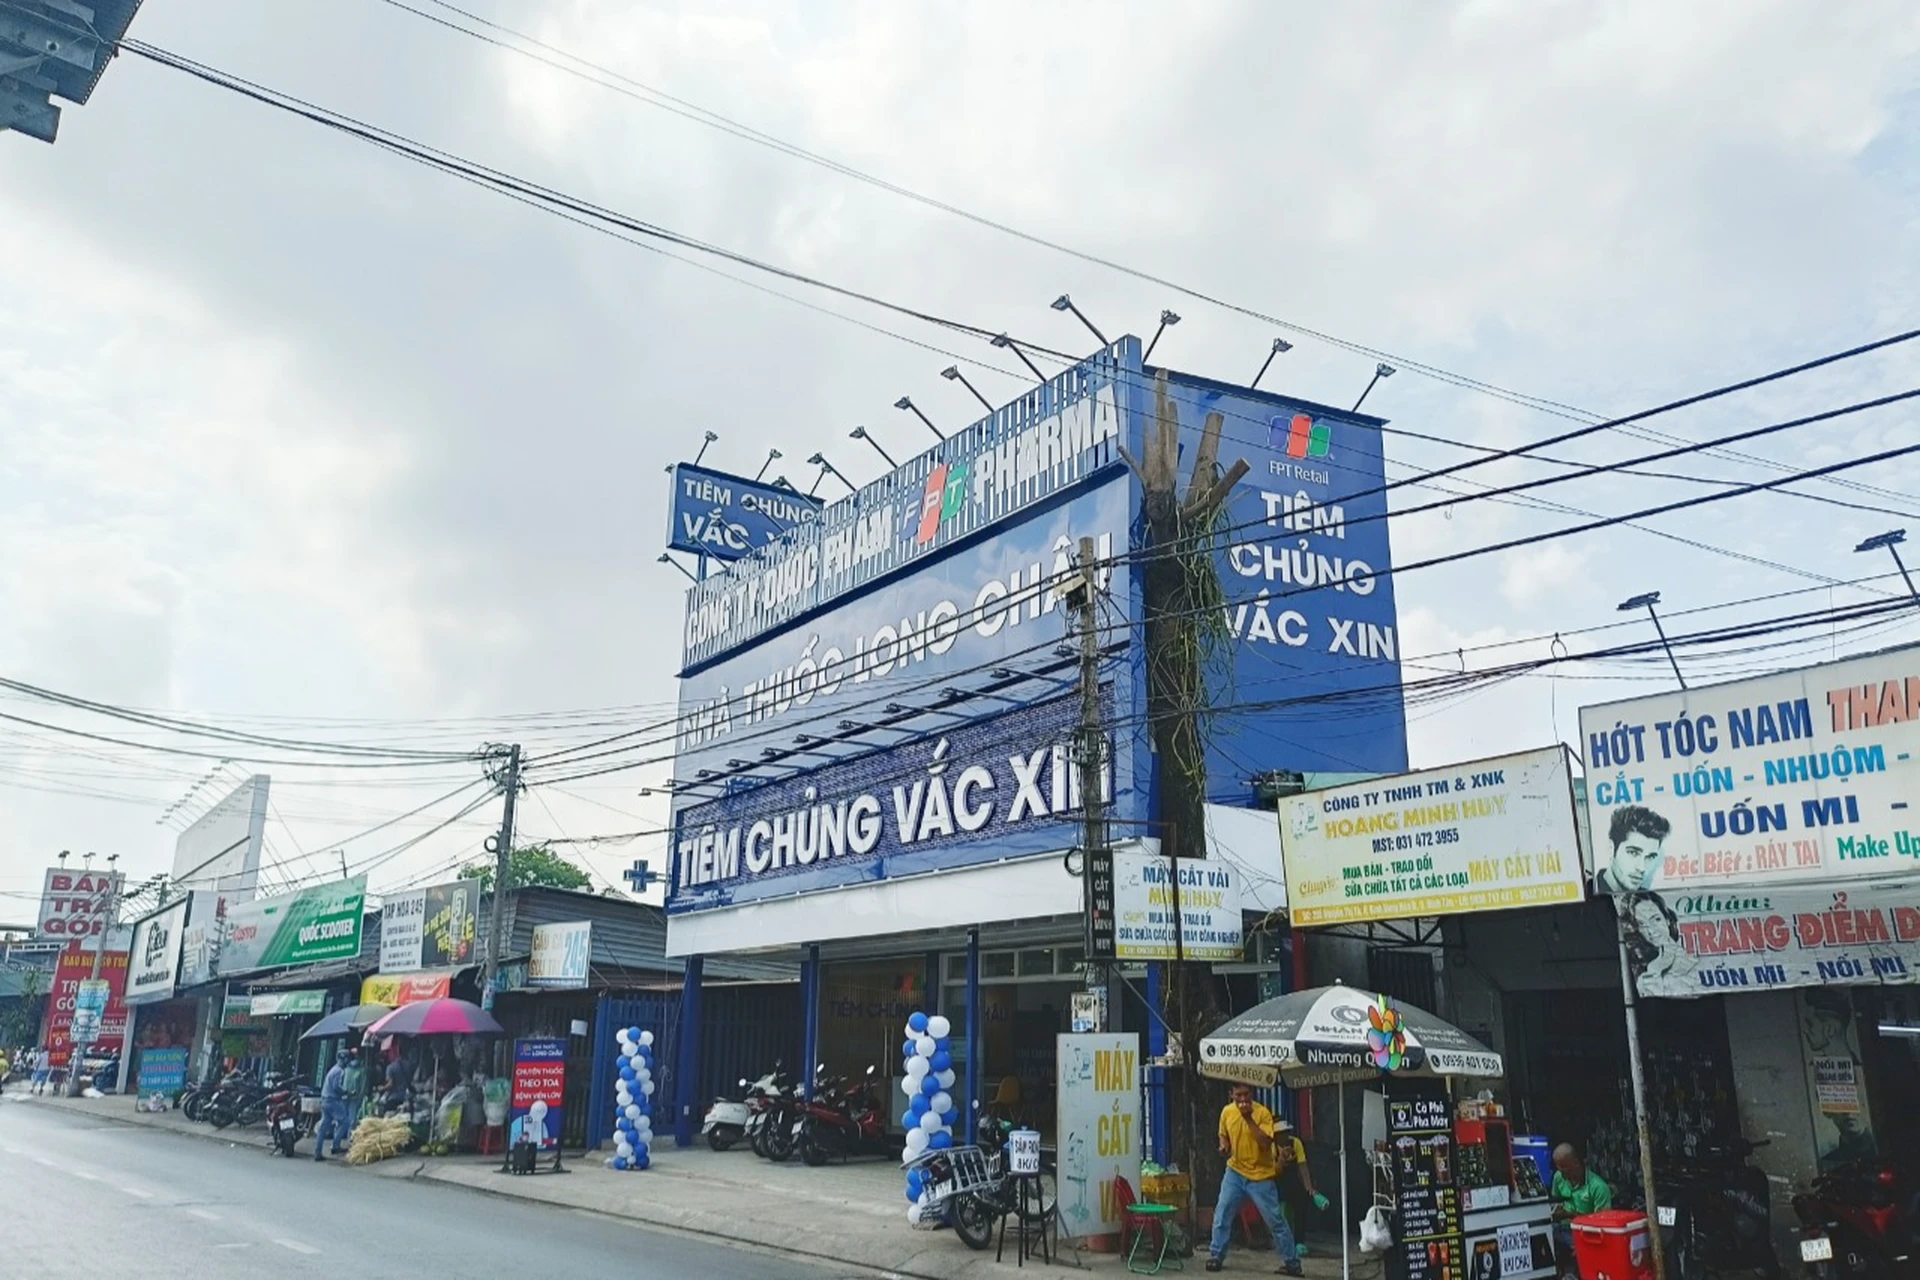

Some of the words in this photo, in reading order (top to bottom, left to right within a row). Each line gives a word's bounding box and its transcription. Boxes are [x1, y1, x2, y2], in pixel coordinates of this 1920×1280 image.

[901, 468, 966, 538] FPT
[974, 383, 1119, 505] PHARMA
[1269, 459, 1292, 478] FPT
[1294, 463, 1329, 485] Retail
[683, 478, 732, 506] TIÊM
[740, 494, 822, 524] CHỦNG
[1260, 489, 1345, 539] TIÊM
[683, 508, 749, 550] VẮC
[1230, 539, 1376, 595] CHỦNG
[1222, 587, 1309, 646] VẮC
[1327, 616, 1396, 661] XIN
[682, 685, 732, 750] NHÀ
[743, 634, 845, 726] THUỐC
[855, 600, 960, 683] LONG
[1590, 720, 1645, 769] HỚT
[1655, 710, 1718, 759] TÓC
[1727, 697, 1813, 750] NAM
[1364, 792, 1379, 807] TY
[1383, 785, 1423, 802] TNHH
[1426, 780, 1449, 796] TM
[1454, 777, 1466, 791] &
[1471, 770, 1505, 788] XNK
[1596, 771, 1645, 806] CẮT
[1673, 760, 1734, 798] UỐN
[1764, 744, 1886, 783] NHUỘM
[678, 825, 741, 888] TIÊM
[745, 786, 884, 872] CHỦNG
[893, 737, 995, 843] VẮC
[1403, 802, 1458, 829] MINH
[1462, 794, 1510, 820] HUY
[1700, 797, 1788, 839] UỐN
[1802, 795, 1860, 828] MI
[1372, 838, 1394, 853] MST:
[1396, 834, 1412, 850] 031
[1415, 832, 1433, 848] 472
[1435, 828, 1459, 845] 3955
[1836, 834, 1889, 861] Make
[1093, 858, 1110, 872] MÁY
[1143, 864, 1174, 884] MÁY
[1179, 864, 1203, 886] CẮT
[1343, 866, 1362, 879] MUA
[1364, 862, 1383, 877] BÁN
[1391, 860, 1414, 874] TRAO
[1416, 852, 1433, 871] ĐỔI
[1469, 855, 1499, 882] MÁY
[1663, 854, 1700, 879] Đặc
[1755, 838, 1790, 870] RÁY
[1792, 839, 1821, 866] TAI
[1345, 880, 1362, 897] SỬA
[1365, 878, 1389, 895] CHỮA
[1391, 875, 1406, 892] TẤT
[1410, 873, 1422, 891] CẢ
[1425, 872, 1444, 888] CÁC
[1446, 872, 1469, 888] LOẠI
[299, 918, 320, 946] QUỐC
[321, 918, 355, 940] SCOOTER
[1679, 914, 1791, 956] TRANG
[1797, 891, 1890, 948] ĐIỂM
[1700, 961, 1748, 987] UỐN
[1754, 966, 1787, 985] MI
[1817, 953, 1863, 979] NỐI
[1870, 956, 1907, 976] MI
[56, 995, 77, 1010] GÓ
[1095, 1041, 1134, 1092] MÁY
[1220, 1044, 1246, 1058] 0936
[1247, 1045, 1267, 1058] 401
[1307, 1049, 1361, 1068] Nhượng
[519, 1079, 541, 1088] THEO
[543, 1079, 559, 1088] TOA
[1413, 1115, 1429, 1128] Pha
[1430, 1115, 1448, 1129] Máy
[1416, 1101, 1427, 1113] Cà
[1428, 1101, 1444, 1113] Phê
[1098, 1099, 1131, 1156] CẮT
